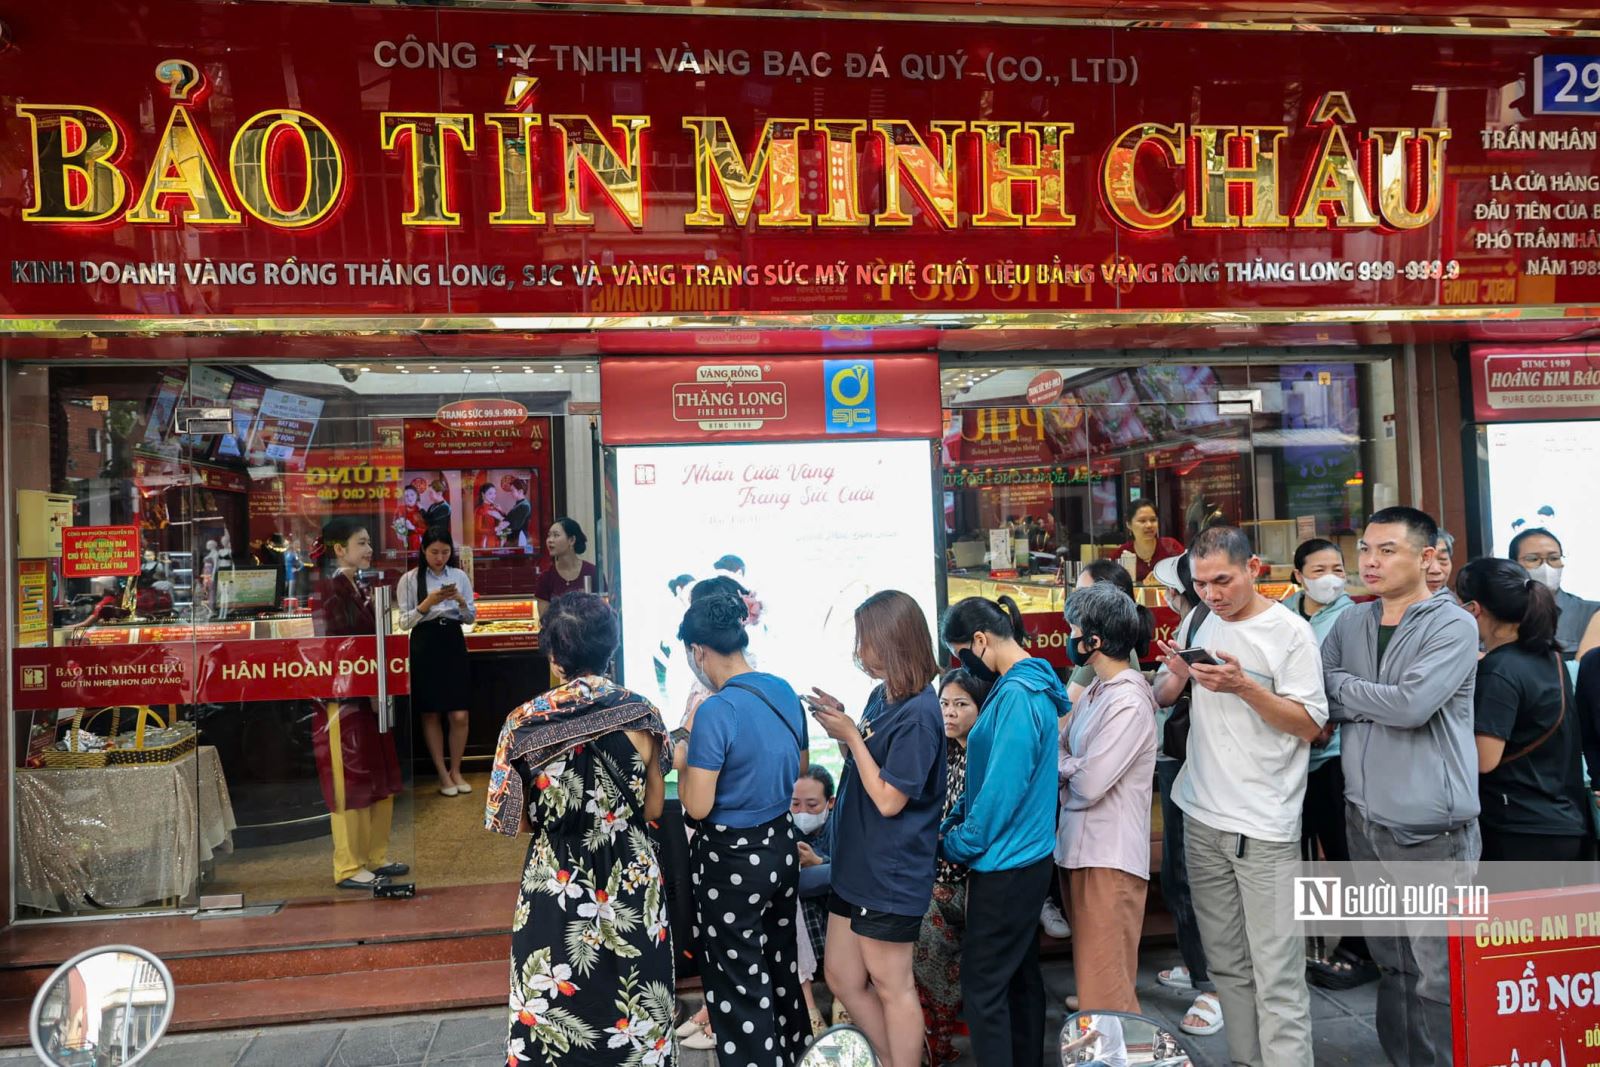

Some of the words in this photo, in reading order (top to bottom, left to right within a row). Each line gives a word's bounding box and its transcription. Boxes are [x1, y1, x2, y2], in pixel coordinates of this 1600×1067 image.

[373, 34, 477, 69] CÔNG
[489, 43, 536, 70] TY
[550, 45, 641, 73] TNHH
[655, 41, 750, 75] VÀNG
[762, 50, 832, 84] BẠC
[844, 46, 890, 79] ĐÁ
[901, 49, 968, 81] QUÝ
[986, 52, 1060, 87] (CO.,
[1071, 56, 1139, 86] LTD)
[16, 59, 344, 228] BẢO
[380, 76, 651, 230] TÍN
[682, 116, 1076, 230] MINH
[1103, 91, 1452, 230] CHÂU
[1480, 124, 1535, 150] TRẦN
[1538, 127, 1597, 150] NHÂN
[1490, 172, 1512, 191] LÀ
[1515, 170, 1548, 192] CỬA
[1551, 172, 1600, 192] HÀNG
[1475, 198, 1510, 220] ĐẦU
[1515, 201, 1551, 220] TIÊN
[1553, 200, 1588, 220] CỦA
[1514, 226, 1560, 249] TRẦN
[1563, 229, 1600, 249] NHÂ
[11, 260, 75, 283] KINH
[80, 261, 177, 284] DOANH
[184, 257, 256, 285] VÀNG
[264, 256, 337, 285] RỒNG
[344, 258, 431, 286] THĂNG
[438, 264, 515, 290] LONG,
[522, 264, 564, 286] SJC
[572, 259, 603, 286] VÀ
[612, 259, 676, 286] VÀNG
[682, 264, 759, 286] TRANG
[764, 259, 809, 286] SỨC
[815, 260, 848, 285] MỸ
[856, 260, 916, 290] NGHỆ
[922, 257, 979, 285] CHẤT
[985, 259, 1030, 289] LIỆU
[1036, 254, 1095, 285] BẰNG
[1101, 256, 1158, 285] VÀNG
[1225, 257, 1295, 282] THĂNG
[1300, 261, 1355, 282] LONG
[1526, 256, 1567, 276] NĂM
[700, 369, 727, 378] VÀNG
[1521, 360, 1548, 368] BTMC
[1550, 359, 1571, 368] 1989
[1491, 368, 1540, 388] HOÀNG
[1543, 371, 1570, 386] KIM
[675, 390, 734, 406] THĂNG
[739, 392, 783, 405] LONG
[1502, 395, 1525, 403] PURE
[1528, 395, 1552, 403] GOLD
[1555, 393, 1595, 402] JEWELRY
[697, 408, 715, 416] FINE
[86, 664, 108, 675] TÍN
[112, 664, 146, 675] MINH
[222, 660, 265, 679] HÂN
[273, 661, 332, 678] HOAN
[79, 678, 91, 688] TÍN
[94, 679, 119, 688] NHIỆM
[121, 677, 139, 686] HƠN
[1475, 917, 1534, 948] CÔNG
[1541, 915, 1568, 941] AN
[1497, 960, 1540, 1015] ĐỀ
